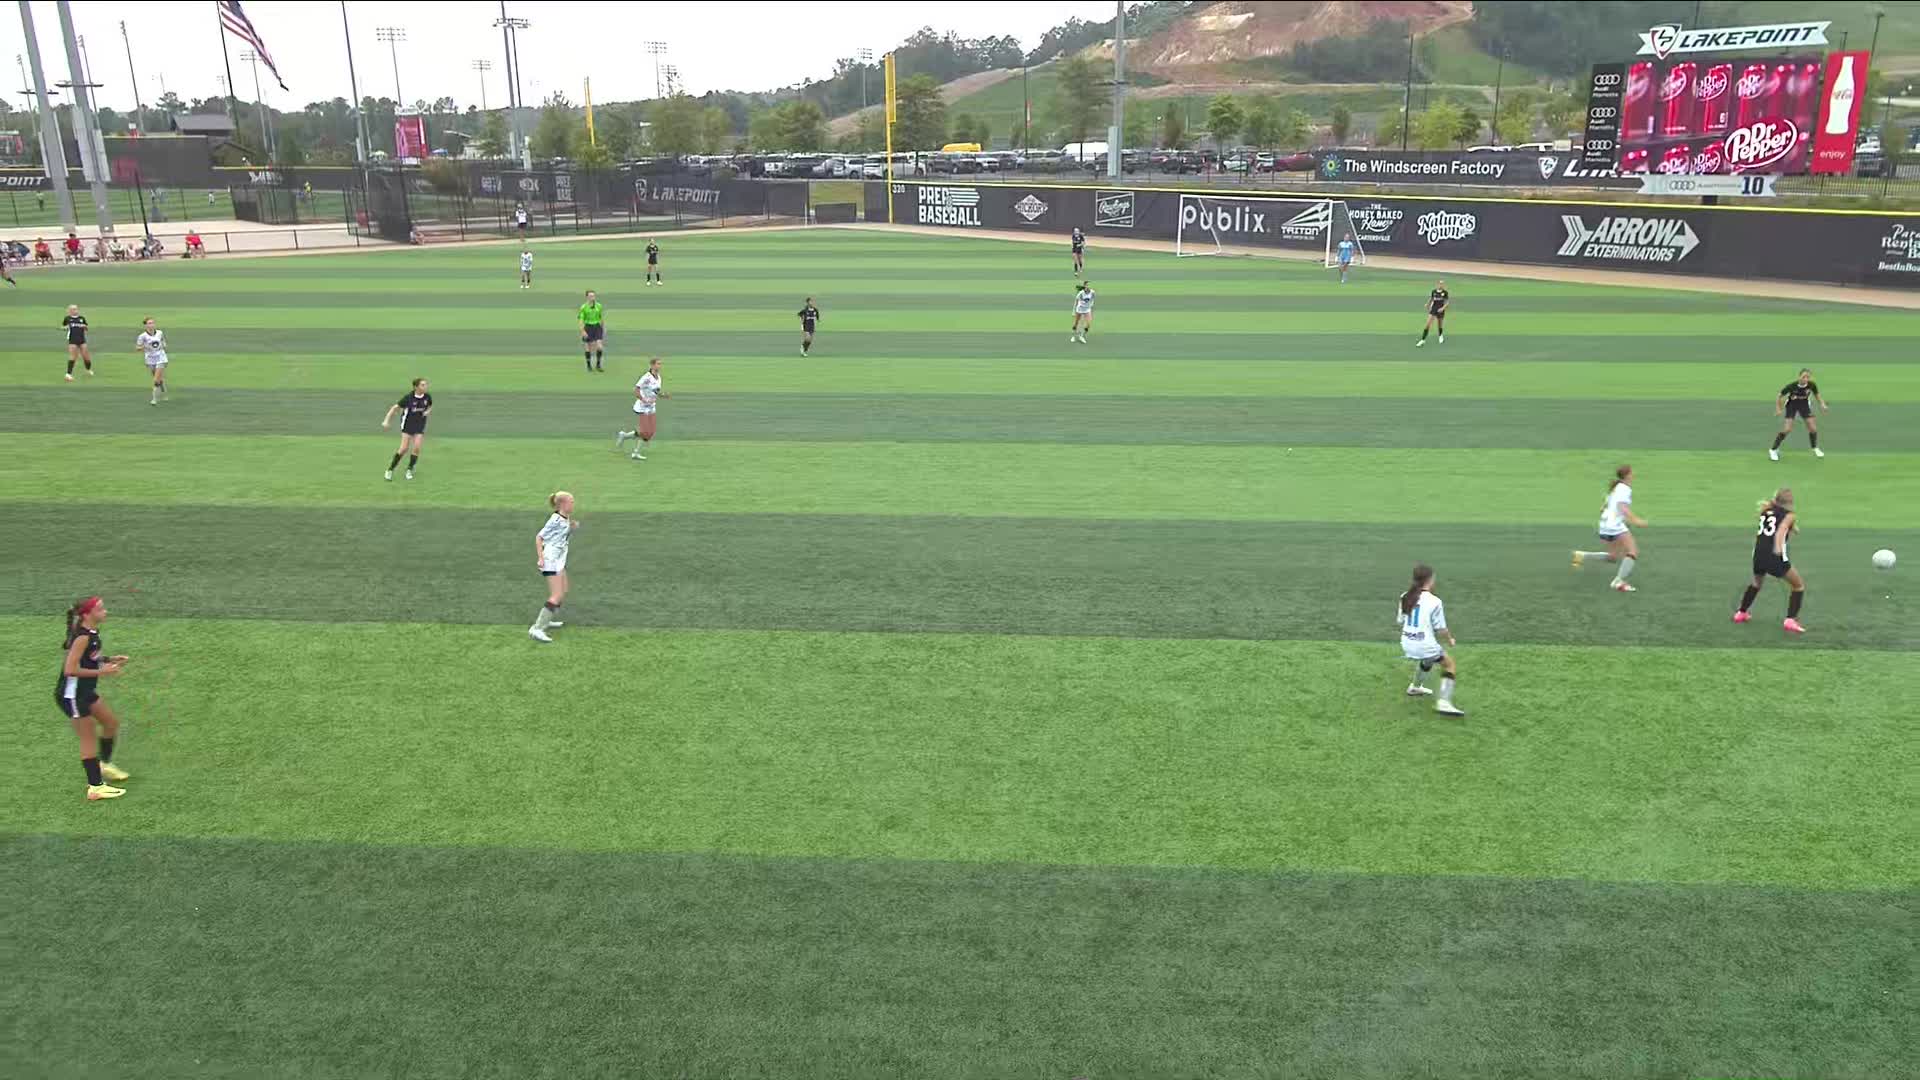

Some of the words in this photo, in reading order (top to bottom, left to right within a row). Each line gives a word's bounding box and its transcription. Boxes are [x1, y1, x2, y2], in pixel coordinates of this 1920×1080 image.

[1679, 26, 1819, 48] LAKEPOINT
[1751, 122, 1777, 142] Dr
[1730, 127, 1792, 163] Pepper
[1819, 151, 1846, 160] enjoy
[1344, 158, 1367, 172] The
[1370, 159, 1447, 174] Windscreen
[1451, 161, 1505, 178] Factory
[652, 187, 720, 203] LAKEPOINT
[918, 186, 950, 205] PREP
[1742, 176, 1765, 195] 10
[918, 205, 981, 226] BASEBALL
[1183, 205, 1264, 233] Publix
[1376, 210, 1403, 219] BAKED
[1417, 210, 1476, 234] Nature's
[1427, 227, 1462, 245] Own
[1590, 216, 1683, 246] ARROW
[1584, 244, 1675, 262] EXTERMINATORS
